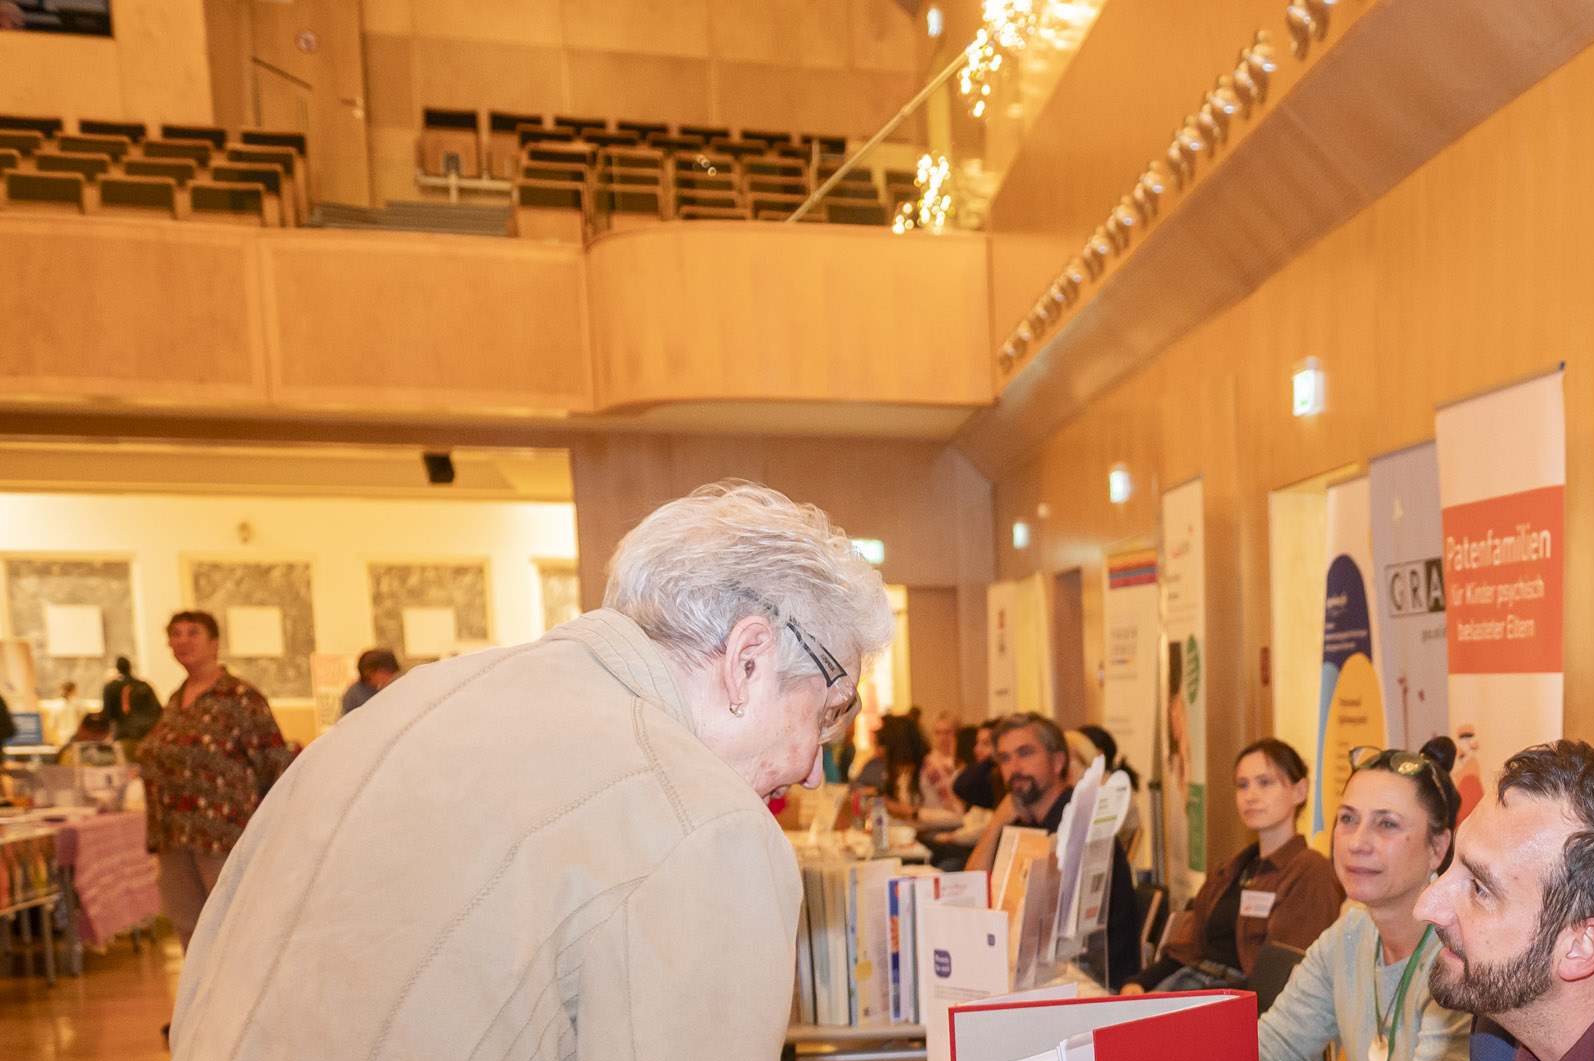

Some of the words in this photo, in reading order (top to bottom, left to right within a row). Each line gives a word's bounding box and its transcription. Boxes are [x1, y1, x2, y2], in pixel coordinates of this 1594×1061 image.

[1445, 524, 1552, 573] Patenfamilien
[1450, 582, 1465, 607] für
[1464, 580, 1496, 605] Kinder
[1496, 575, 1545, 609] psychisch
[1456, 618, 1506, 642] belasteter
[1505, 613, 1536, 640] Eltern
